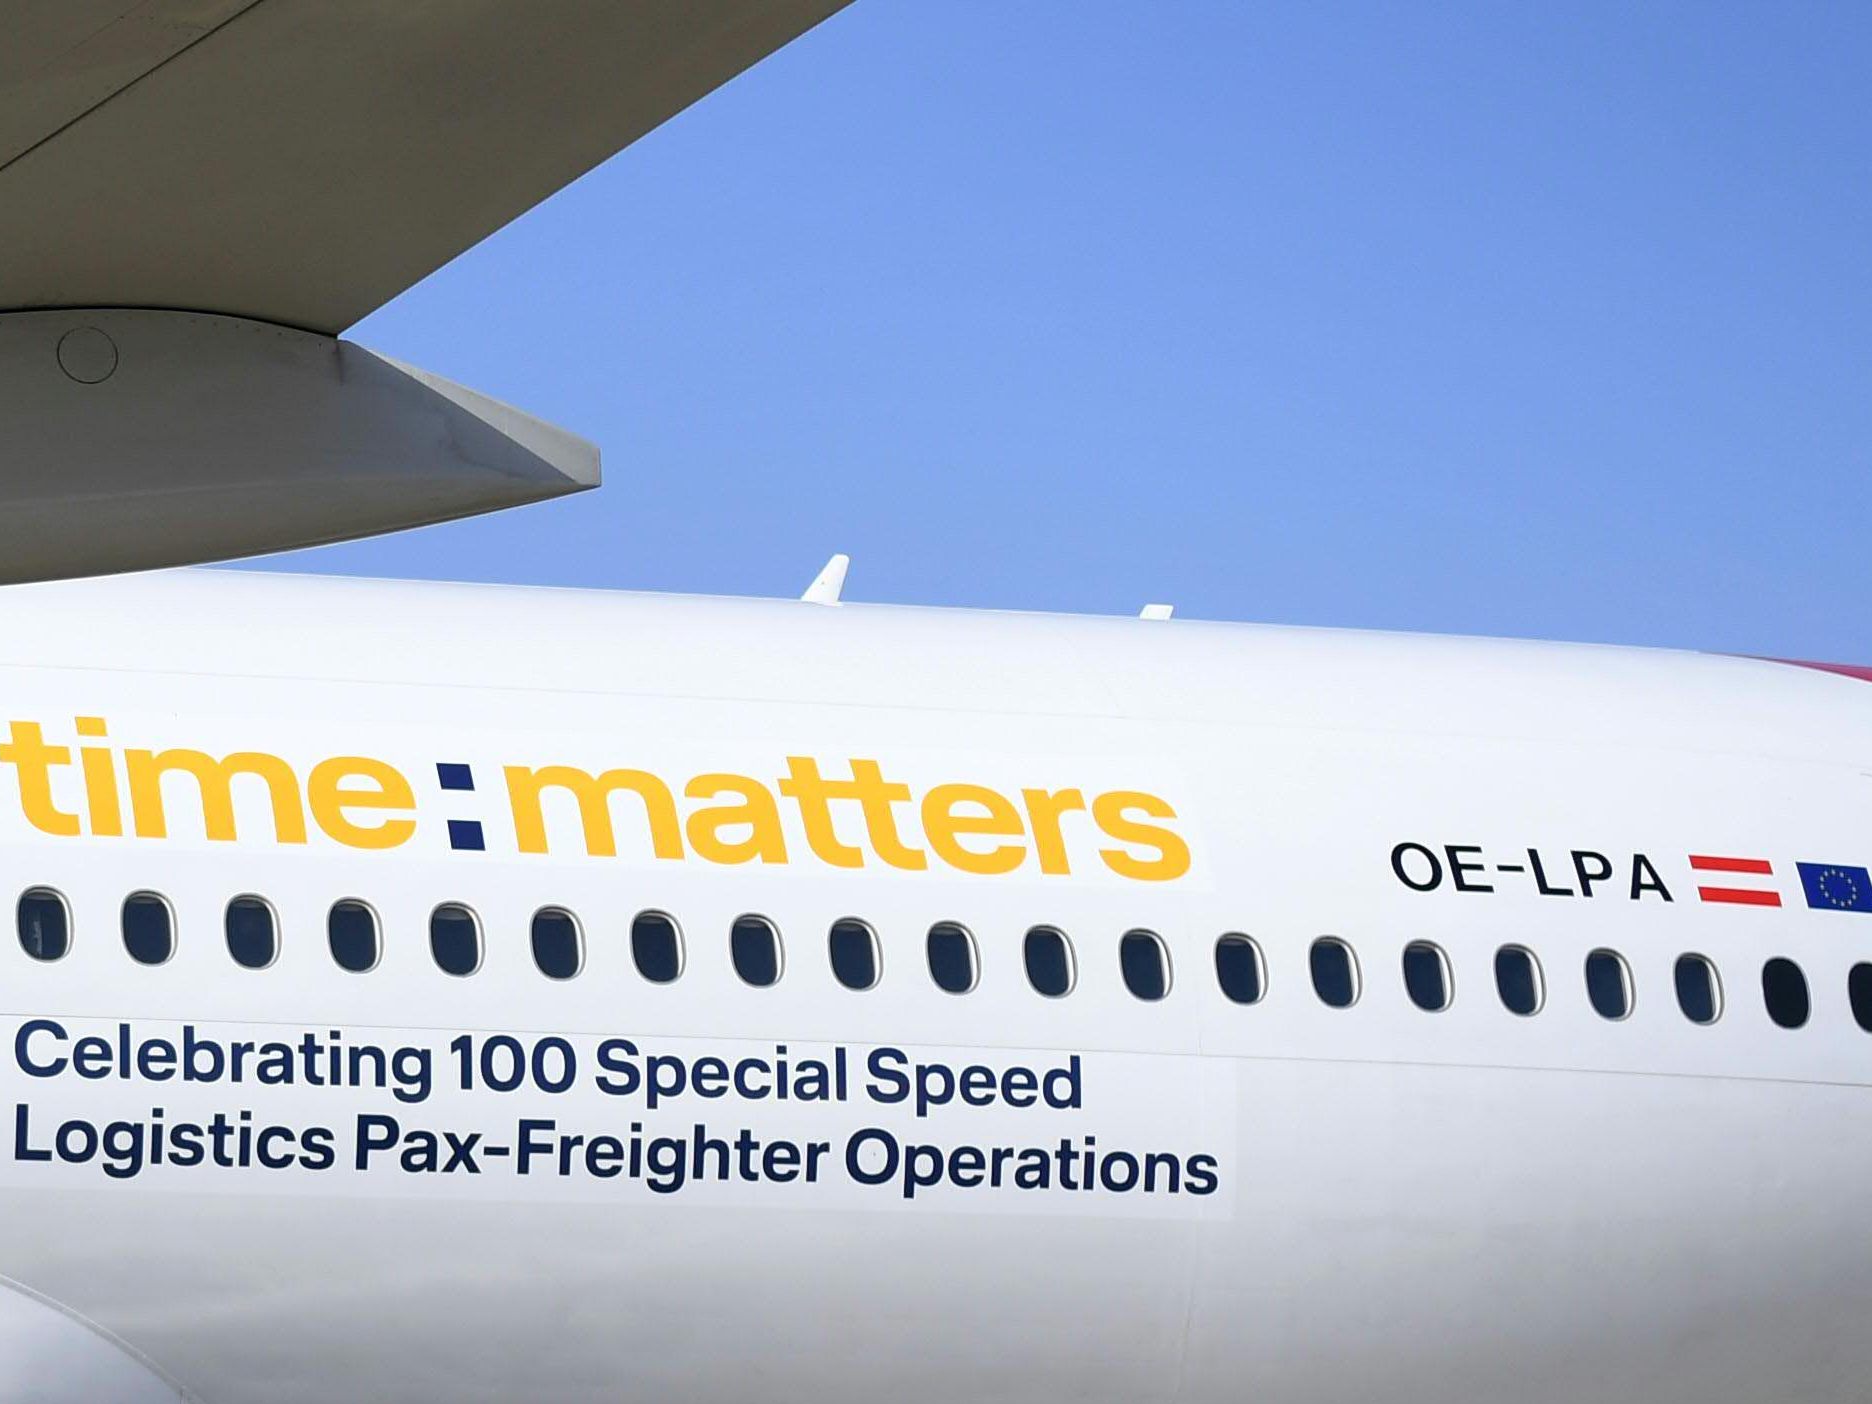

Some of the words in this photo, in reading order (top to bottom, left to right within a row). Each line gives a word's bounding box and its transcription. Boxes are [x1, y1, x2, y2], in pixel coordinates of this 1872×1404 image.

[1390, 842, 1674, 903] OE-LPA
[14, 1019, 432, 1104] Celebrating
[450, 1034, 577, 1094] 100
[595, 1038, 847, 1111] Special
[865, 1047, 1082, 1119] Speed
[14, 1103, 335, 1179] Logistics
[355, 1113, 831, 1194] Pax-Freighter
[845, 1127, 1219, 1200] Operations
